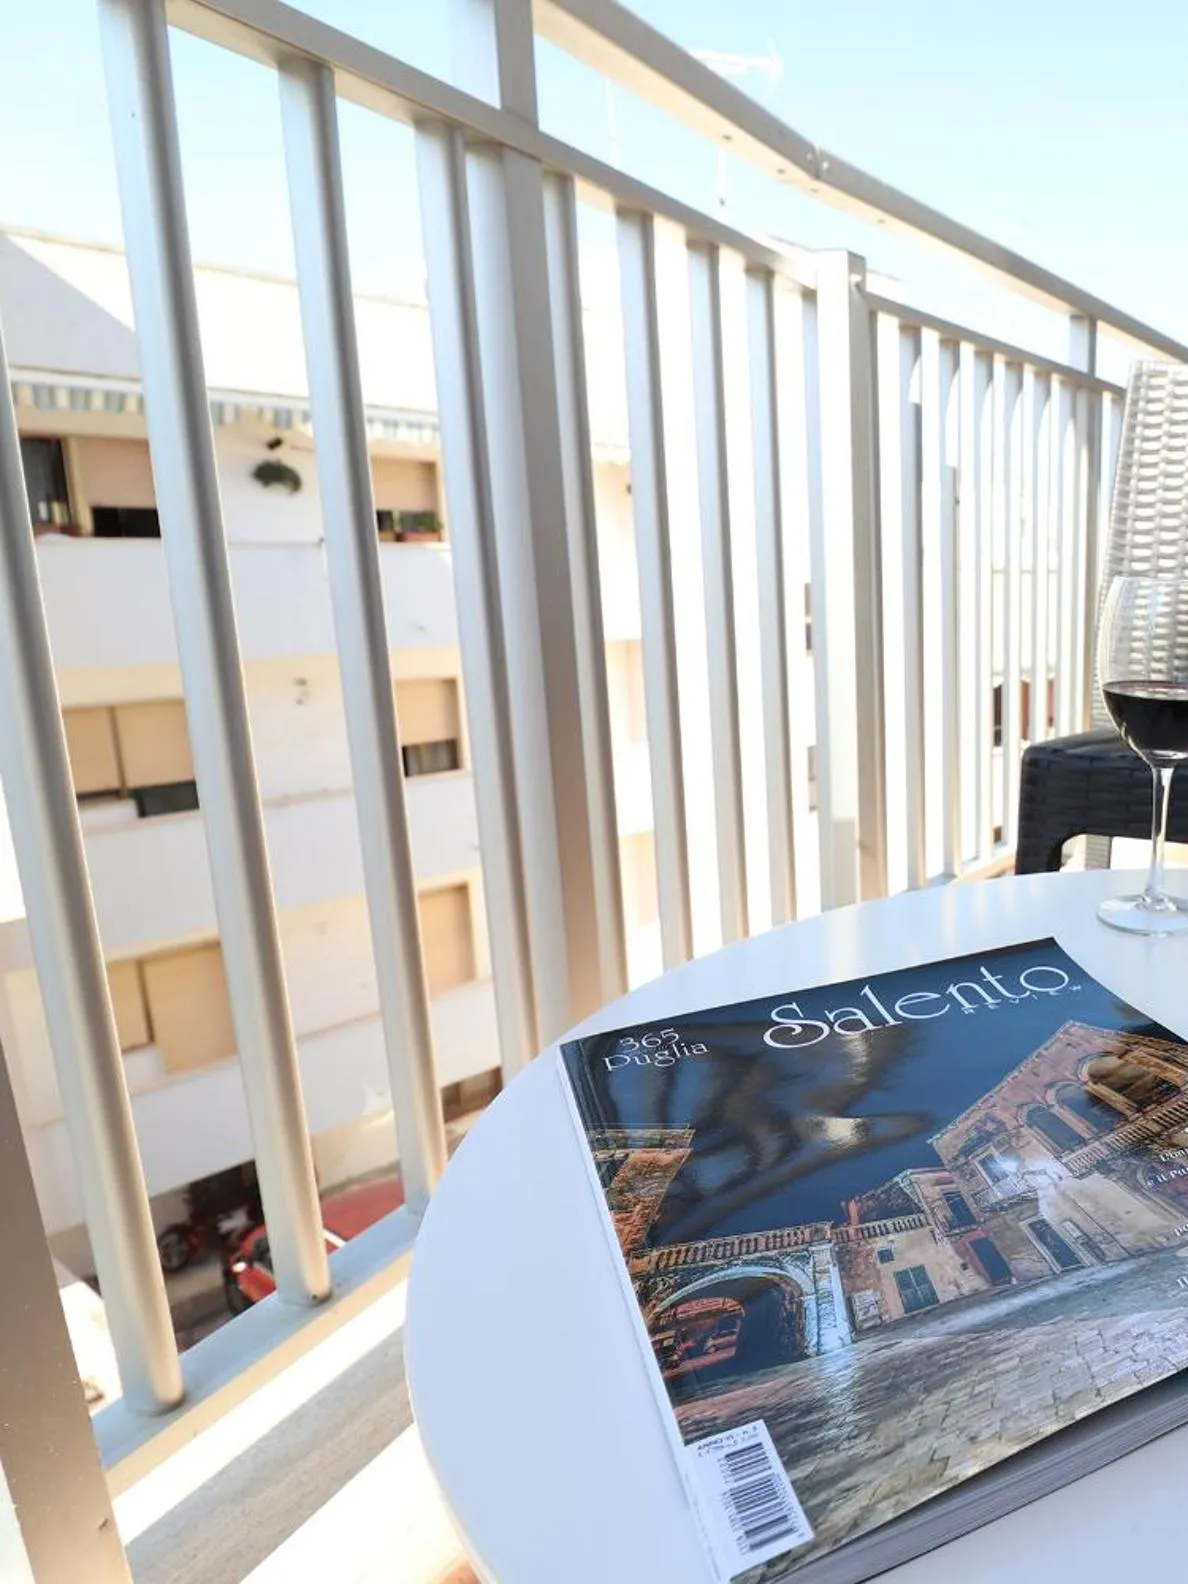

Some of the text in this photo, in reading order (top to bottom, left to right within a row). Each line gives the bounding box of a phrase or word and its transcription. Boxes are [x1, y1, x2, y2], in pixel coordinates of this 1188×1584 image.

[763, 966, 1069, 1050] Salento
[619, 1027, 680, 1054] 365
[603, 1042, 710, 1072] Puglia
